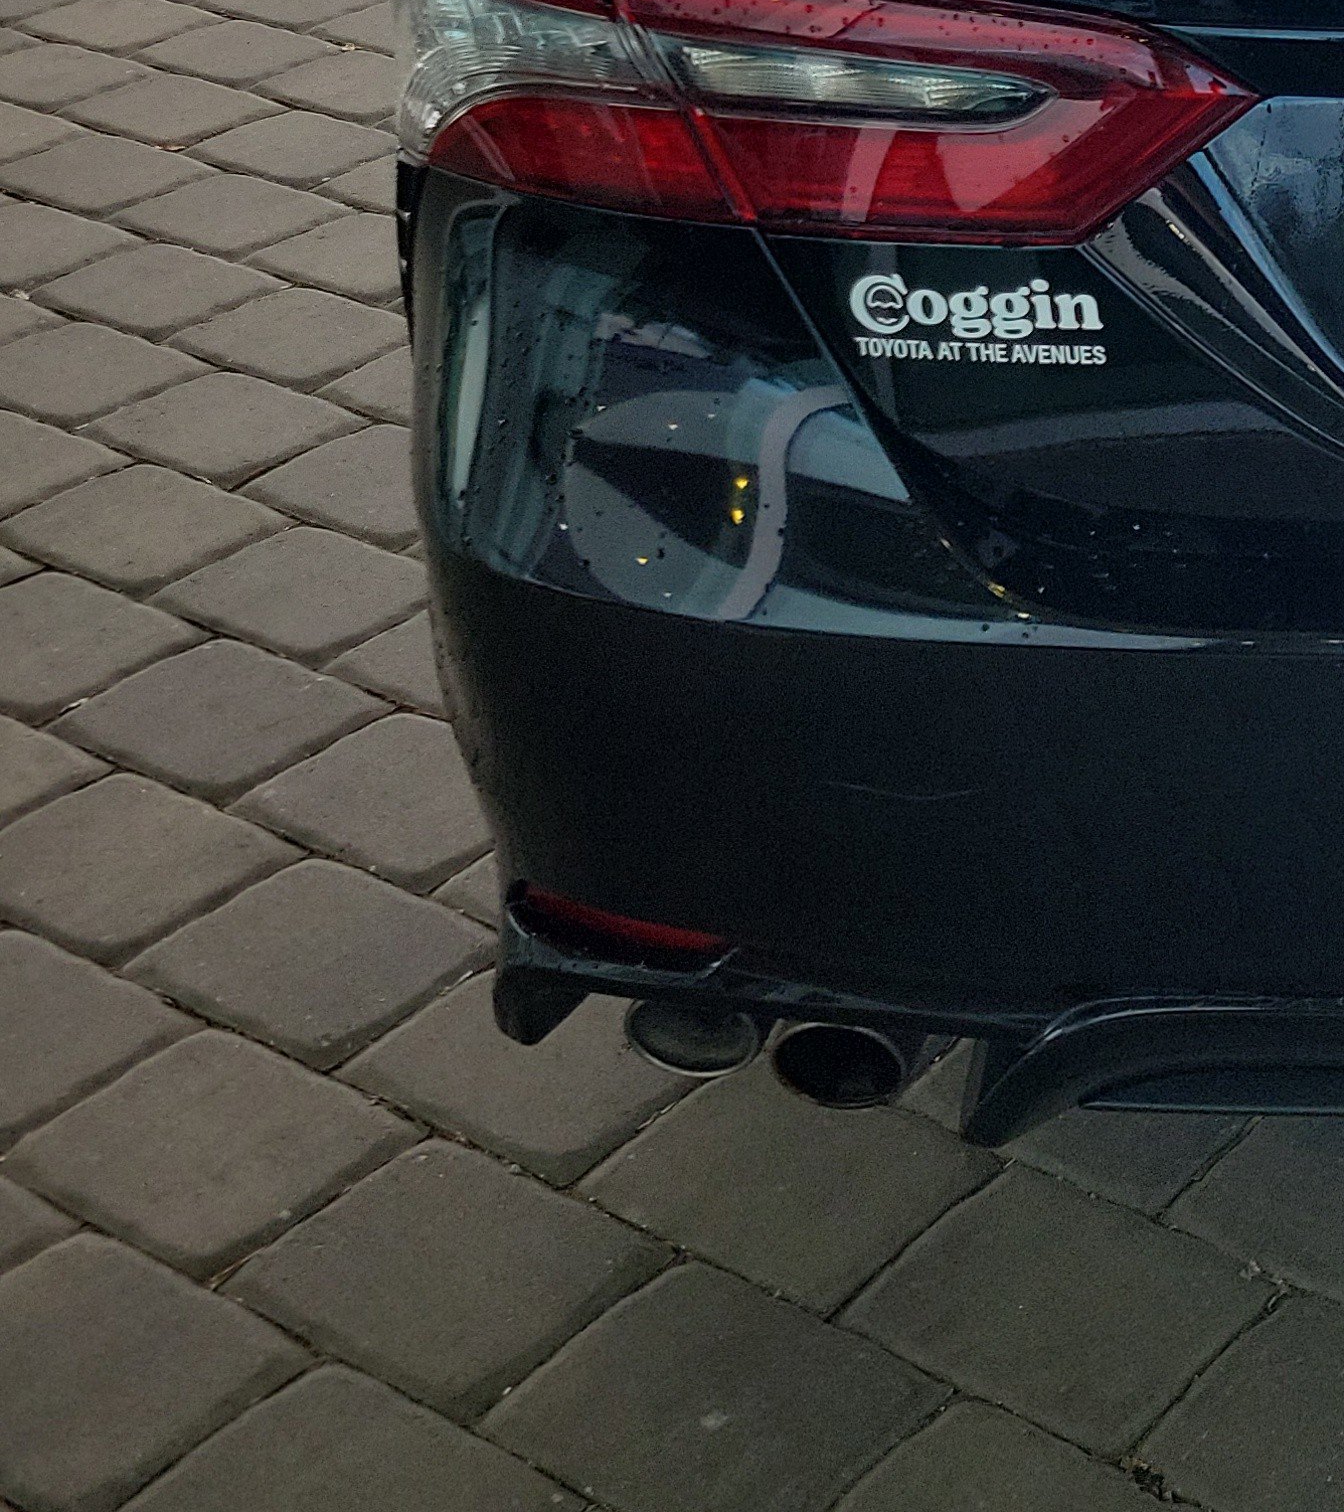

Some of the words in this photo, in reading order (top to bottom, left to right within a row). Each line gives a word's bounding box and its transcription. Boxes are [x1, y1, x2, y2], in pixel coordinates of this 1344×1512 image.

[850, 273, 1104, 339] Coggin
[854, 336, 934, 360] TOYOTA
[937, 341, 963, 362] AT
[964, 342, 1009, 363] THE
[1011, 344, 1107, 365] AVENUES
